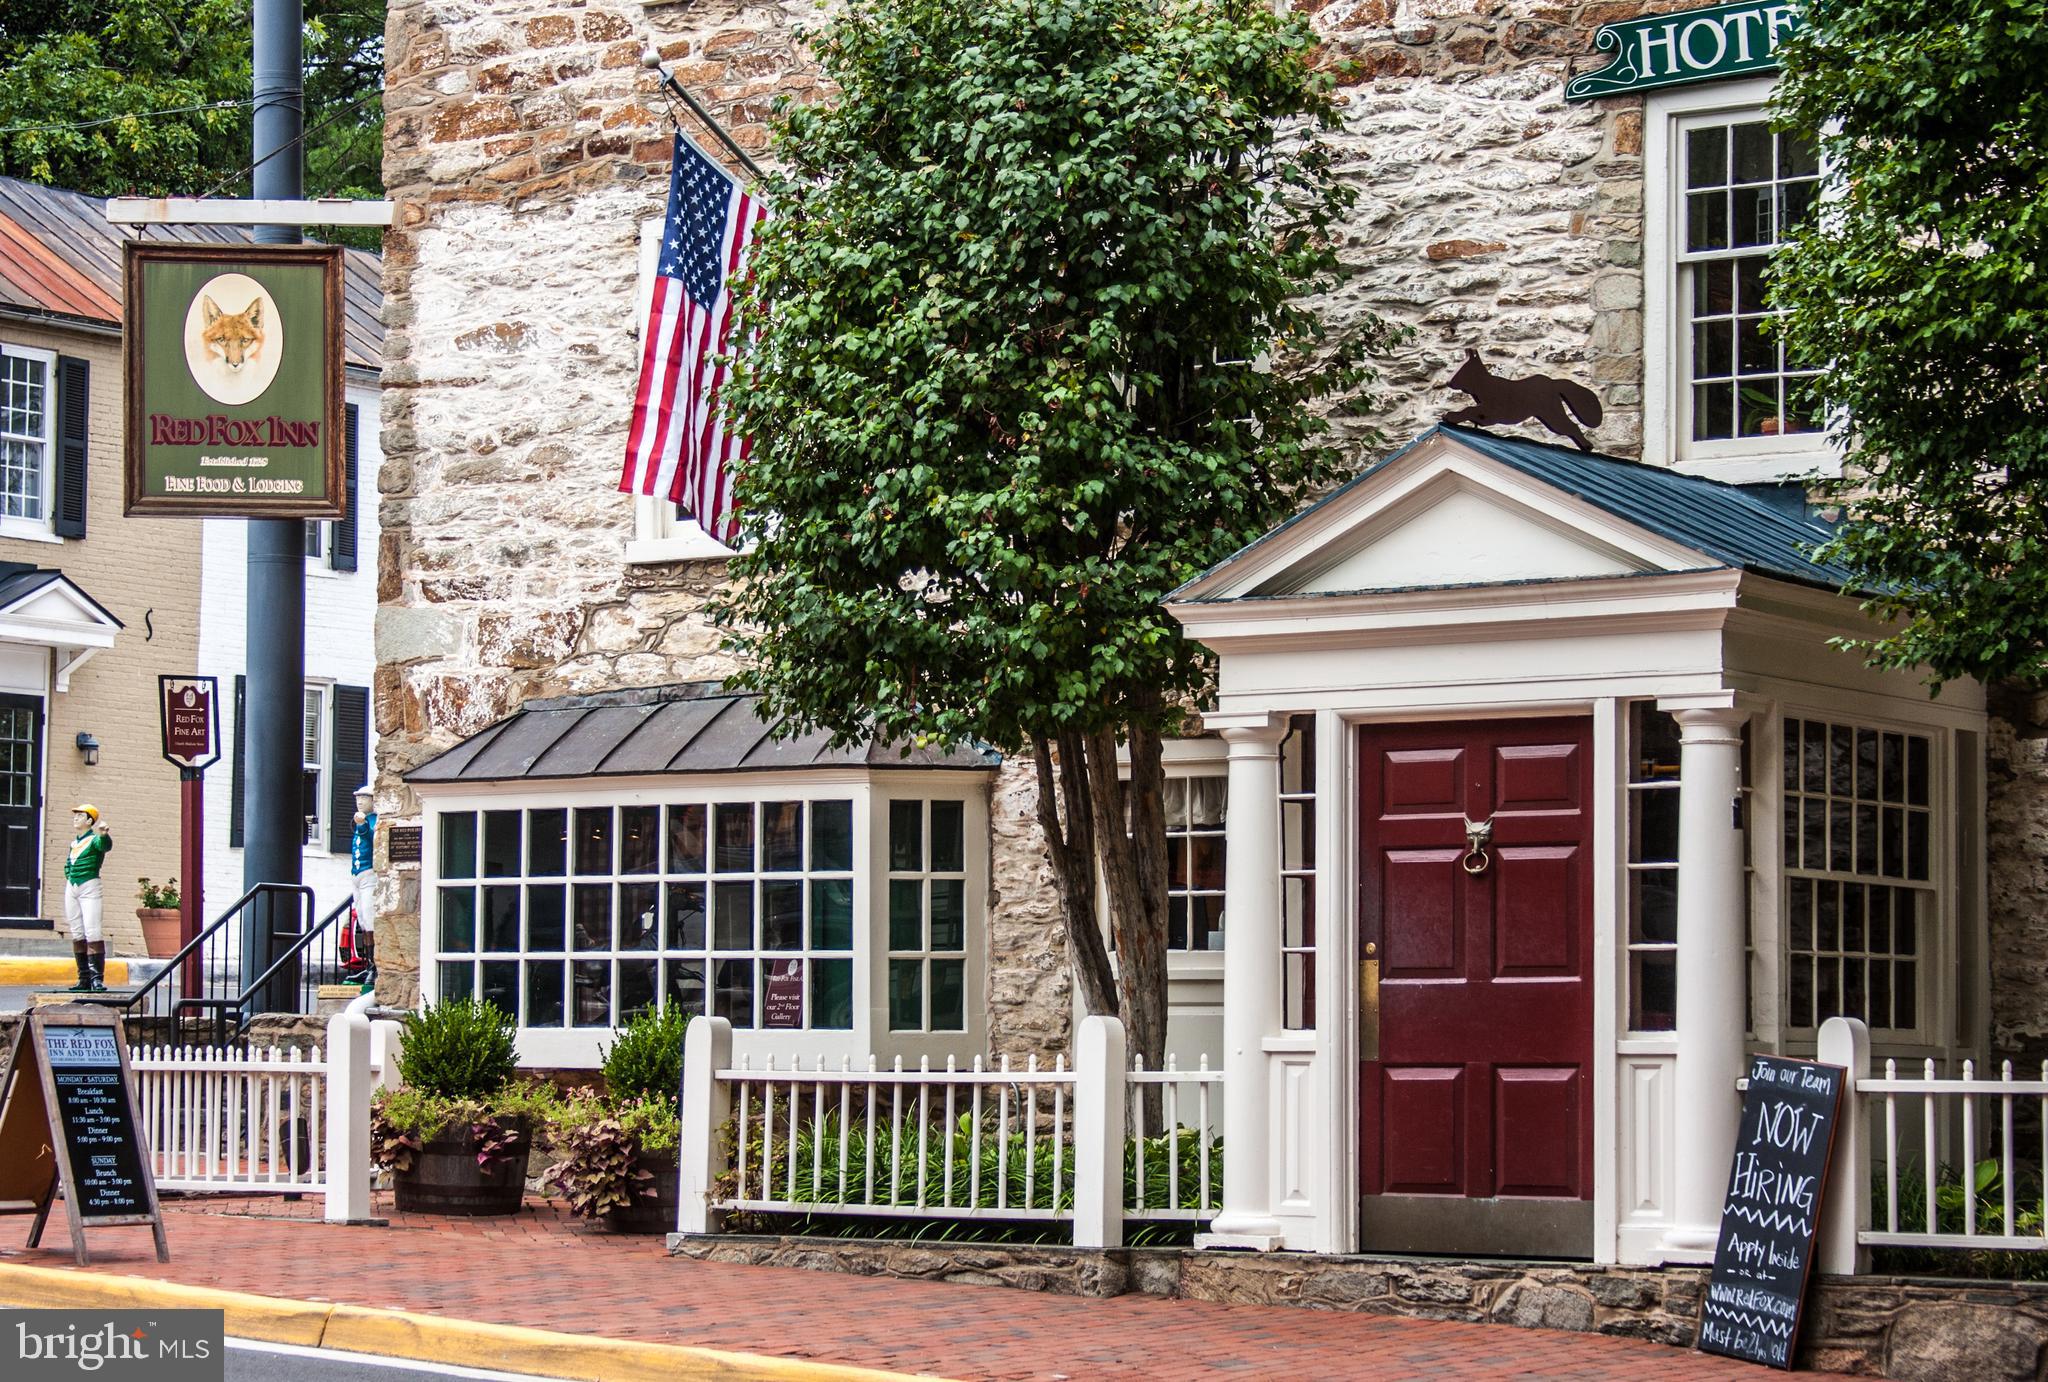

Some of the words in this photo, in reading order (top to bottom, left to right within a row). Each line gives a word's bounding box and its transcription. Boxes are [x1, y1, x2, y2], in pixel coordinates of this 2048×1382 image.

[1637, 4, 1799, 78] HOTE
[206, 414, 267, 447] FOX
[267, 415, 321, 448] INN
[165, 475, 195, 492] FINE
[196, 476, 231, 493] FOOD
[232, 477, 246, 493] &
[248, 477, 304, 494] LODGING
[771, 993, 788, 1001] Please
[771, 1012, 791, 1020] Gallery
[47, 1039, 69, 1049] THE
[70, 1039, 92, 1049] RED
[94, 1039, 115, 1049] FOX
[49, 1049, 65, 1057] INN
[67, 1049, 85, 1057] AND
[86, 1049, 117, 1057] TAVERN
[1752, 1061, 1776, 1082] Join
[1780, 1069, 1799, 1084] our
[1800, 1066, 1831, 1095] Team
[77, 1087, 104, 1095] Breakfast
[84, 1107, 104, 1115] Lunch
[1752, 1101, 1824, 1155] NOW
[95, 1169, 117, 1177] Brunch
[100, 1189, 120, 1197] Dinner
[1728, 1232, 1765, 1267] Apply
[1702, 1321, 1732, 1349] Must
